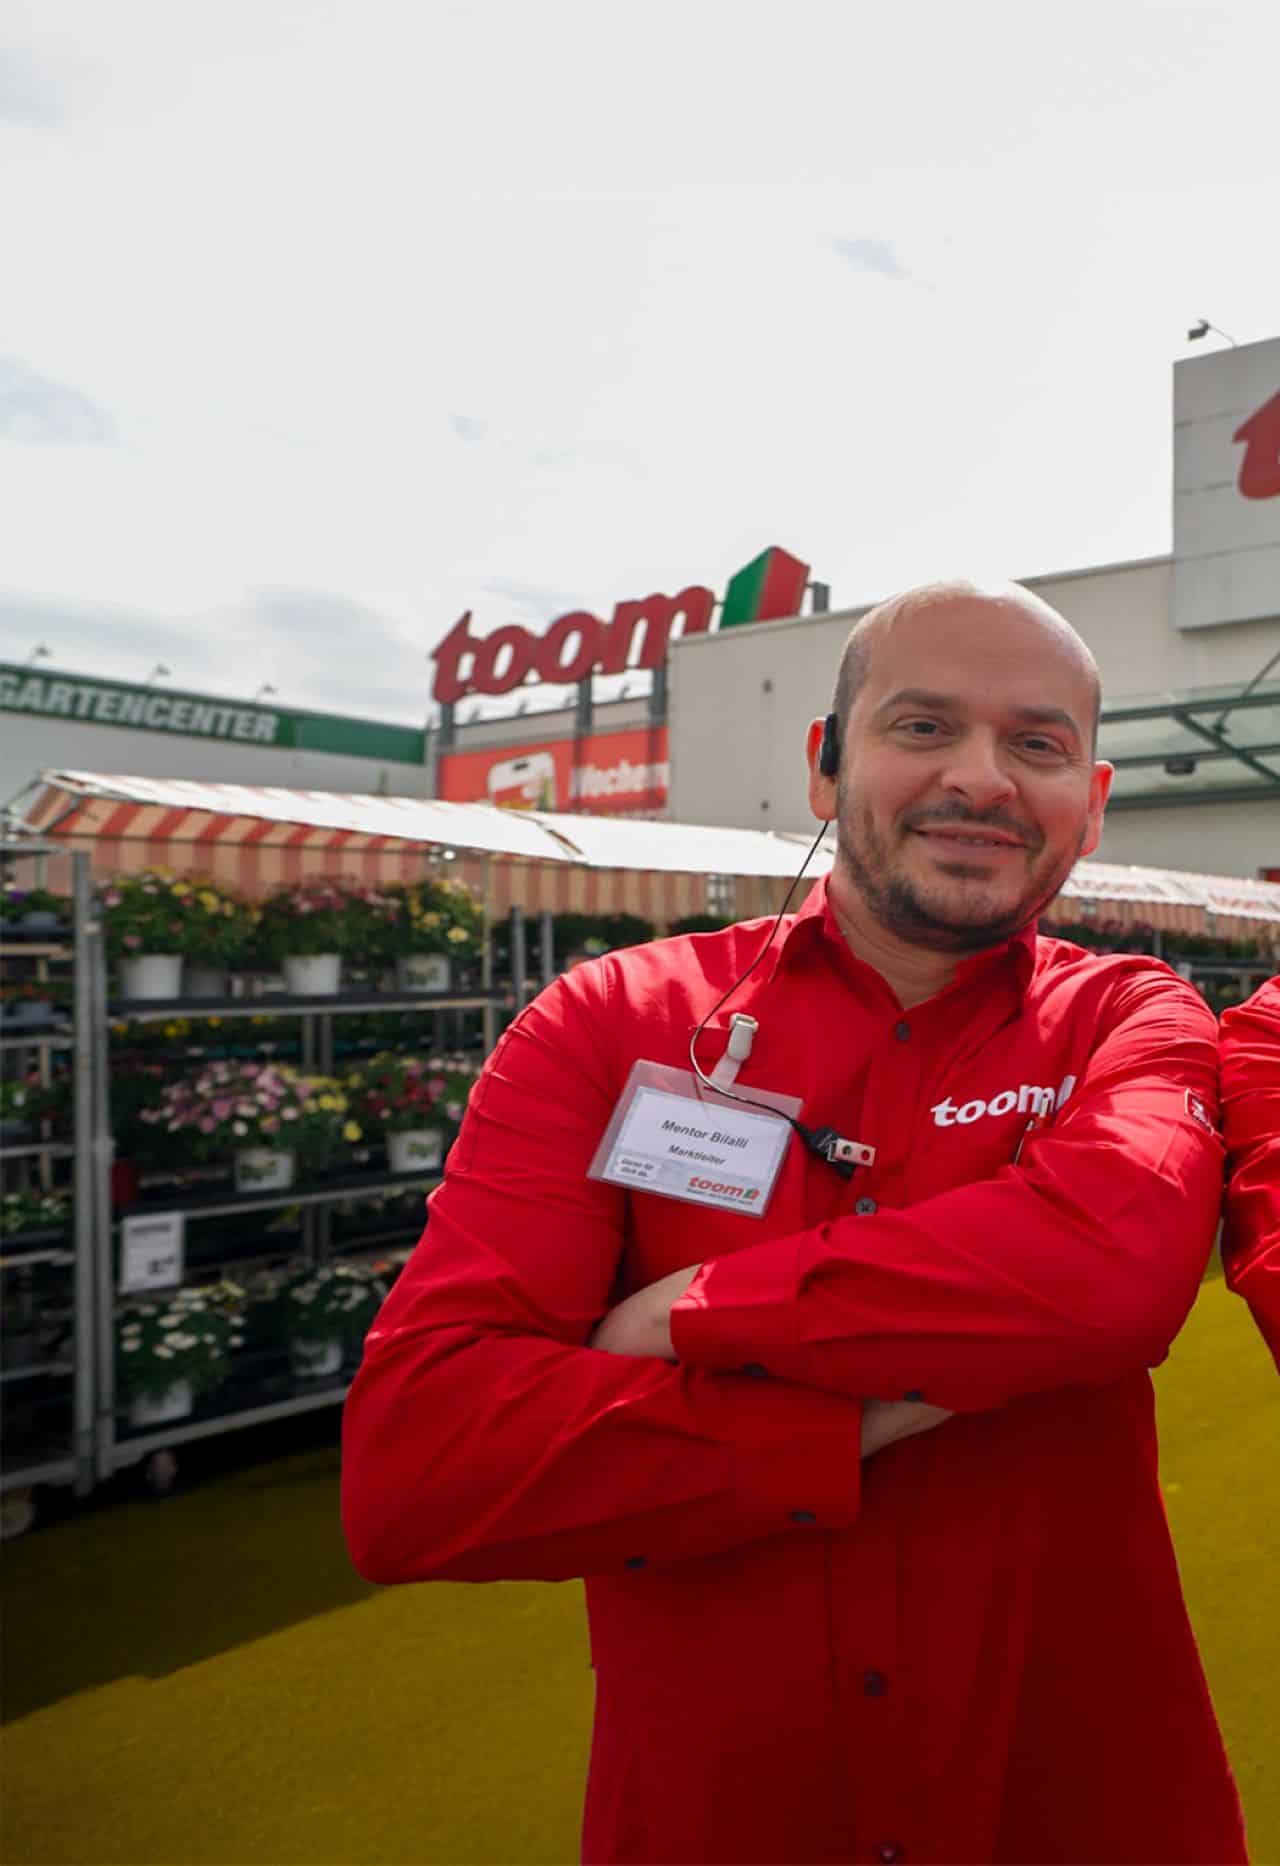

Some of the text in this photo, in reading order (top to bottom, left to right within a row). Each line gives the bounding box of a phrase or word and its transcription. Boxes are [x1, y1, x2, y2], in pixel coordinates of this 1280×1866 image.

[431, 585, 716, 703] toom
[0, 672, 280, 742] GARTENCENTER
[930, 1083, 1054, 1127] toom
[661, 1119, 708, 1139] Mentor
[688, 1175, 744, 1198] toom
